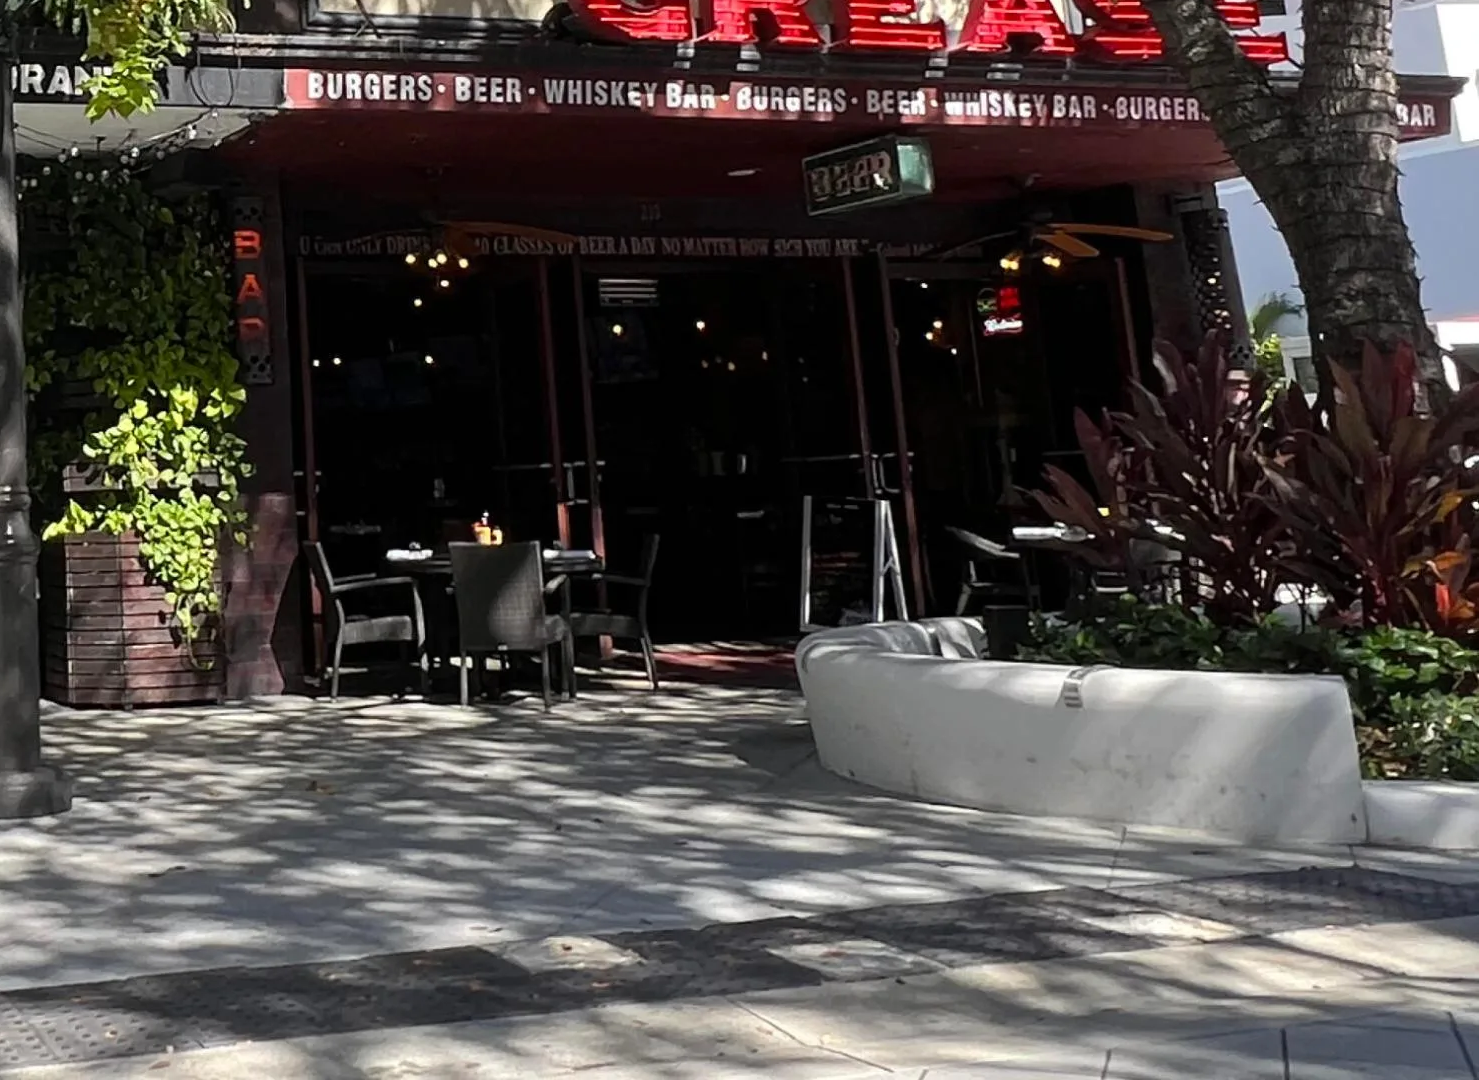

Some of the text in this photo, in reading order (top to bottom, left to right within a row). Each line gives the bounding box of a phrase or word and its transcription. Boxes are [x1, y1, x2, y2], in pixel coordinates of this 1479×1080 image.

[308, 72, 1437, 127] BURGERS BEER WHISKEY BAR BURGERS BEER WHISKEY BAR BURGER BAR
